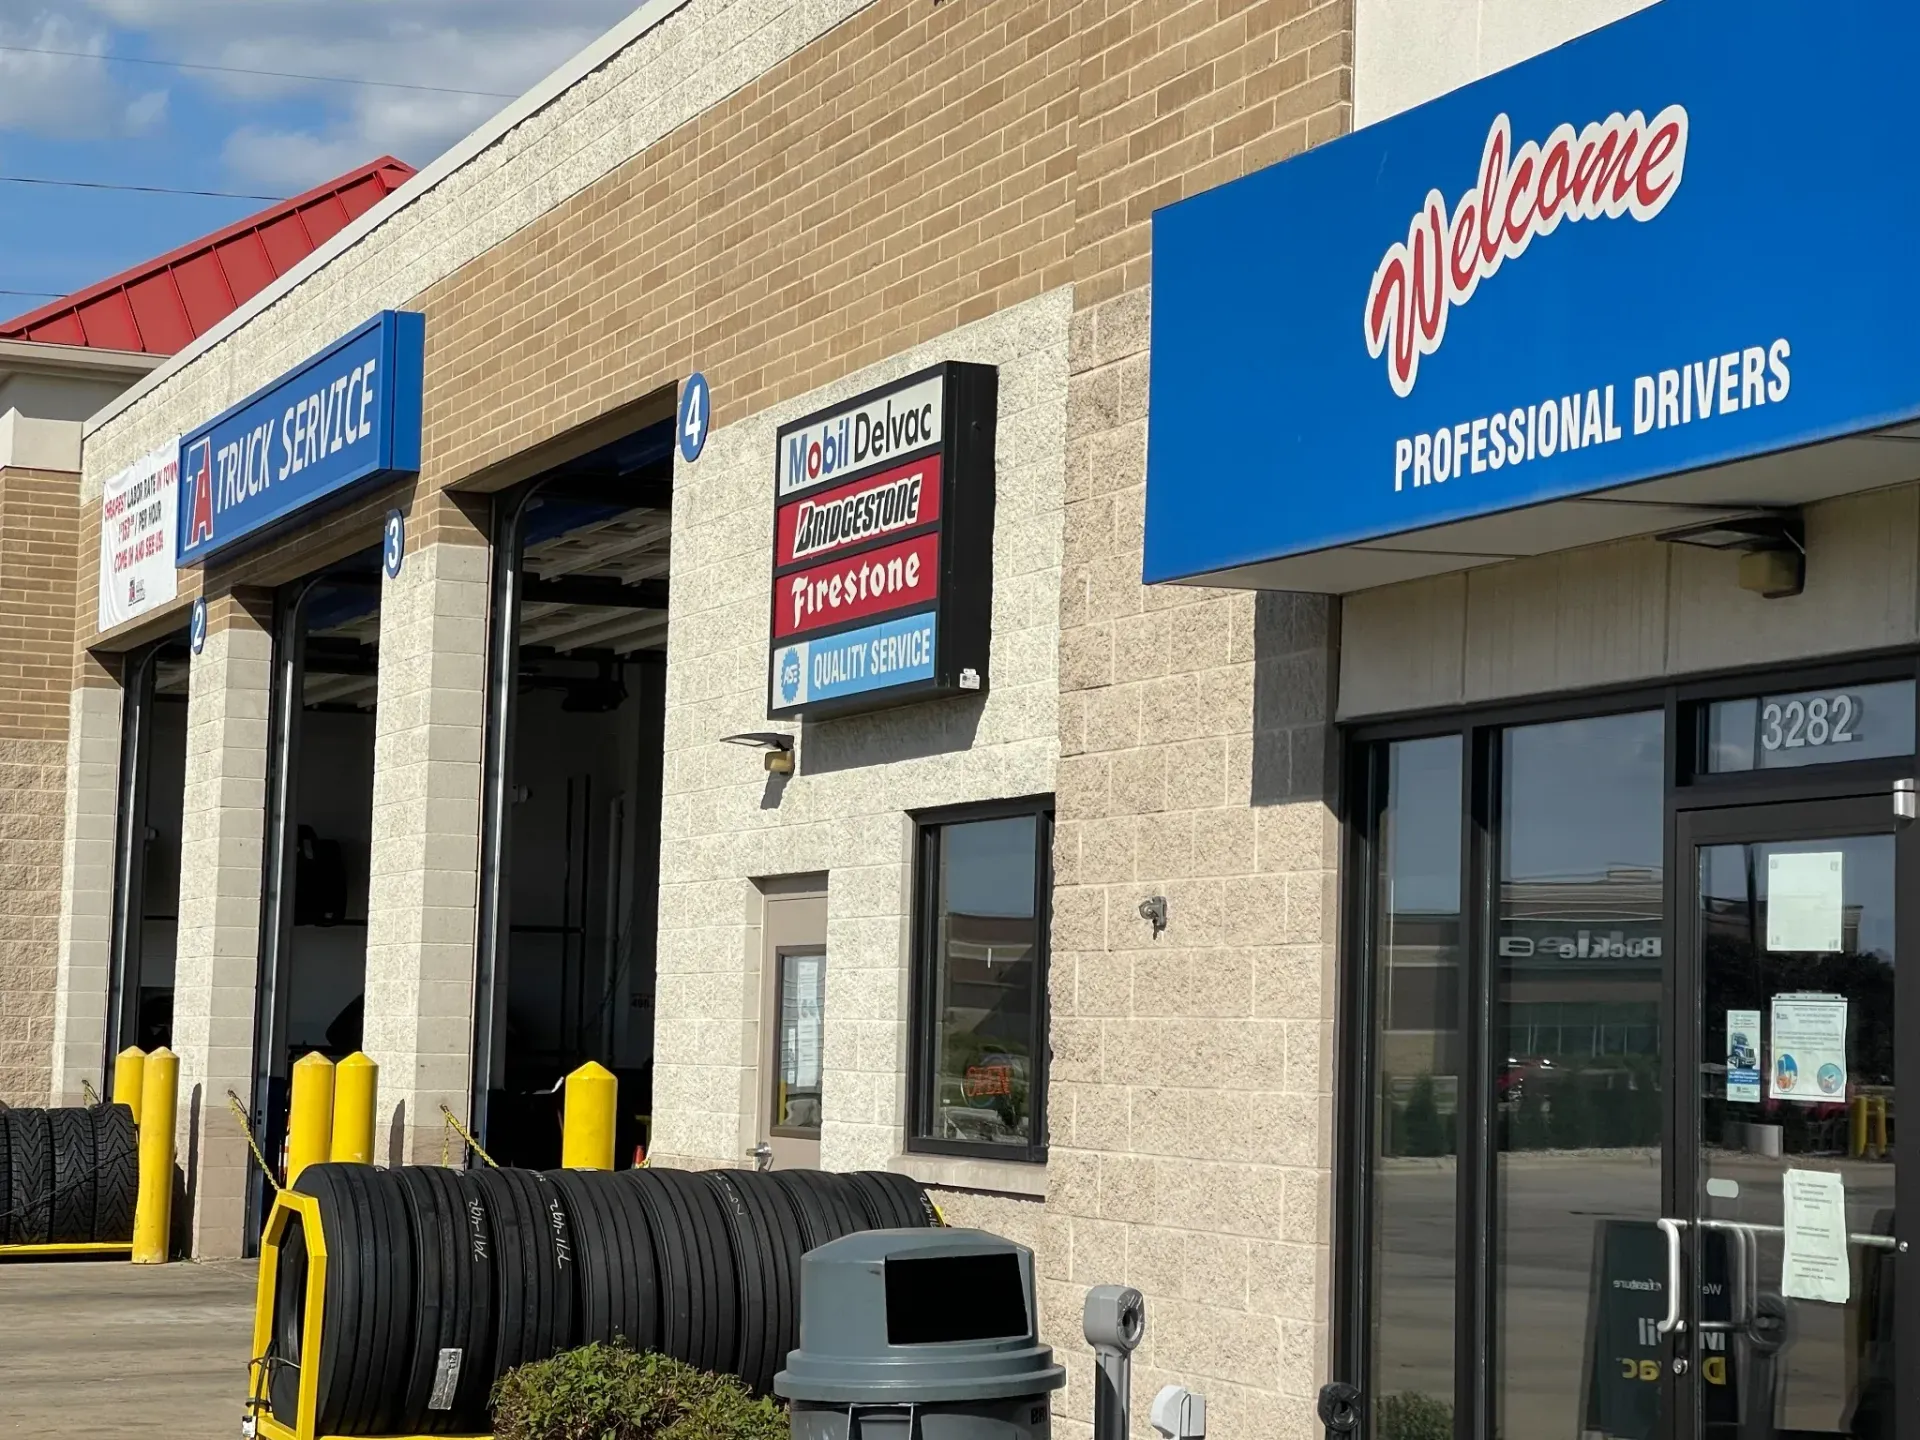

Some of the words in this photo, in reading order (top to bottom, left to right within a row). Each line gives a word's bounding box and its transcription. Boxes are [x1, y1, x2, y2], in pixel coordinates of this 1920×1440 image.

[1366, 108, 1686, 392] Welcome
[217, 418, 275, 514] TRUCK
[279, 358, 376, 481] SERVICE
[685, 384, 701, 447] 4
[788, 416, 850, 487] Mobil
[853, 400, 932, 463] Delvac
[1395, 384, 1622, 492] PROFESSIONAL
[1633, 338, 1791, 436] DRIVERS
[389, 516, 400, 569] 3
[794, 475, 922, 556] BRIDGESTONE
[194, 604, 203, 648] 2
[791, 552, 920, 629] Firestone
[813, 642, 868, 690] QUALITY
[870, 629, 930, 675] SERVICE
[1761, 694, 1853, 751] 3282
